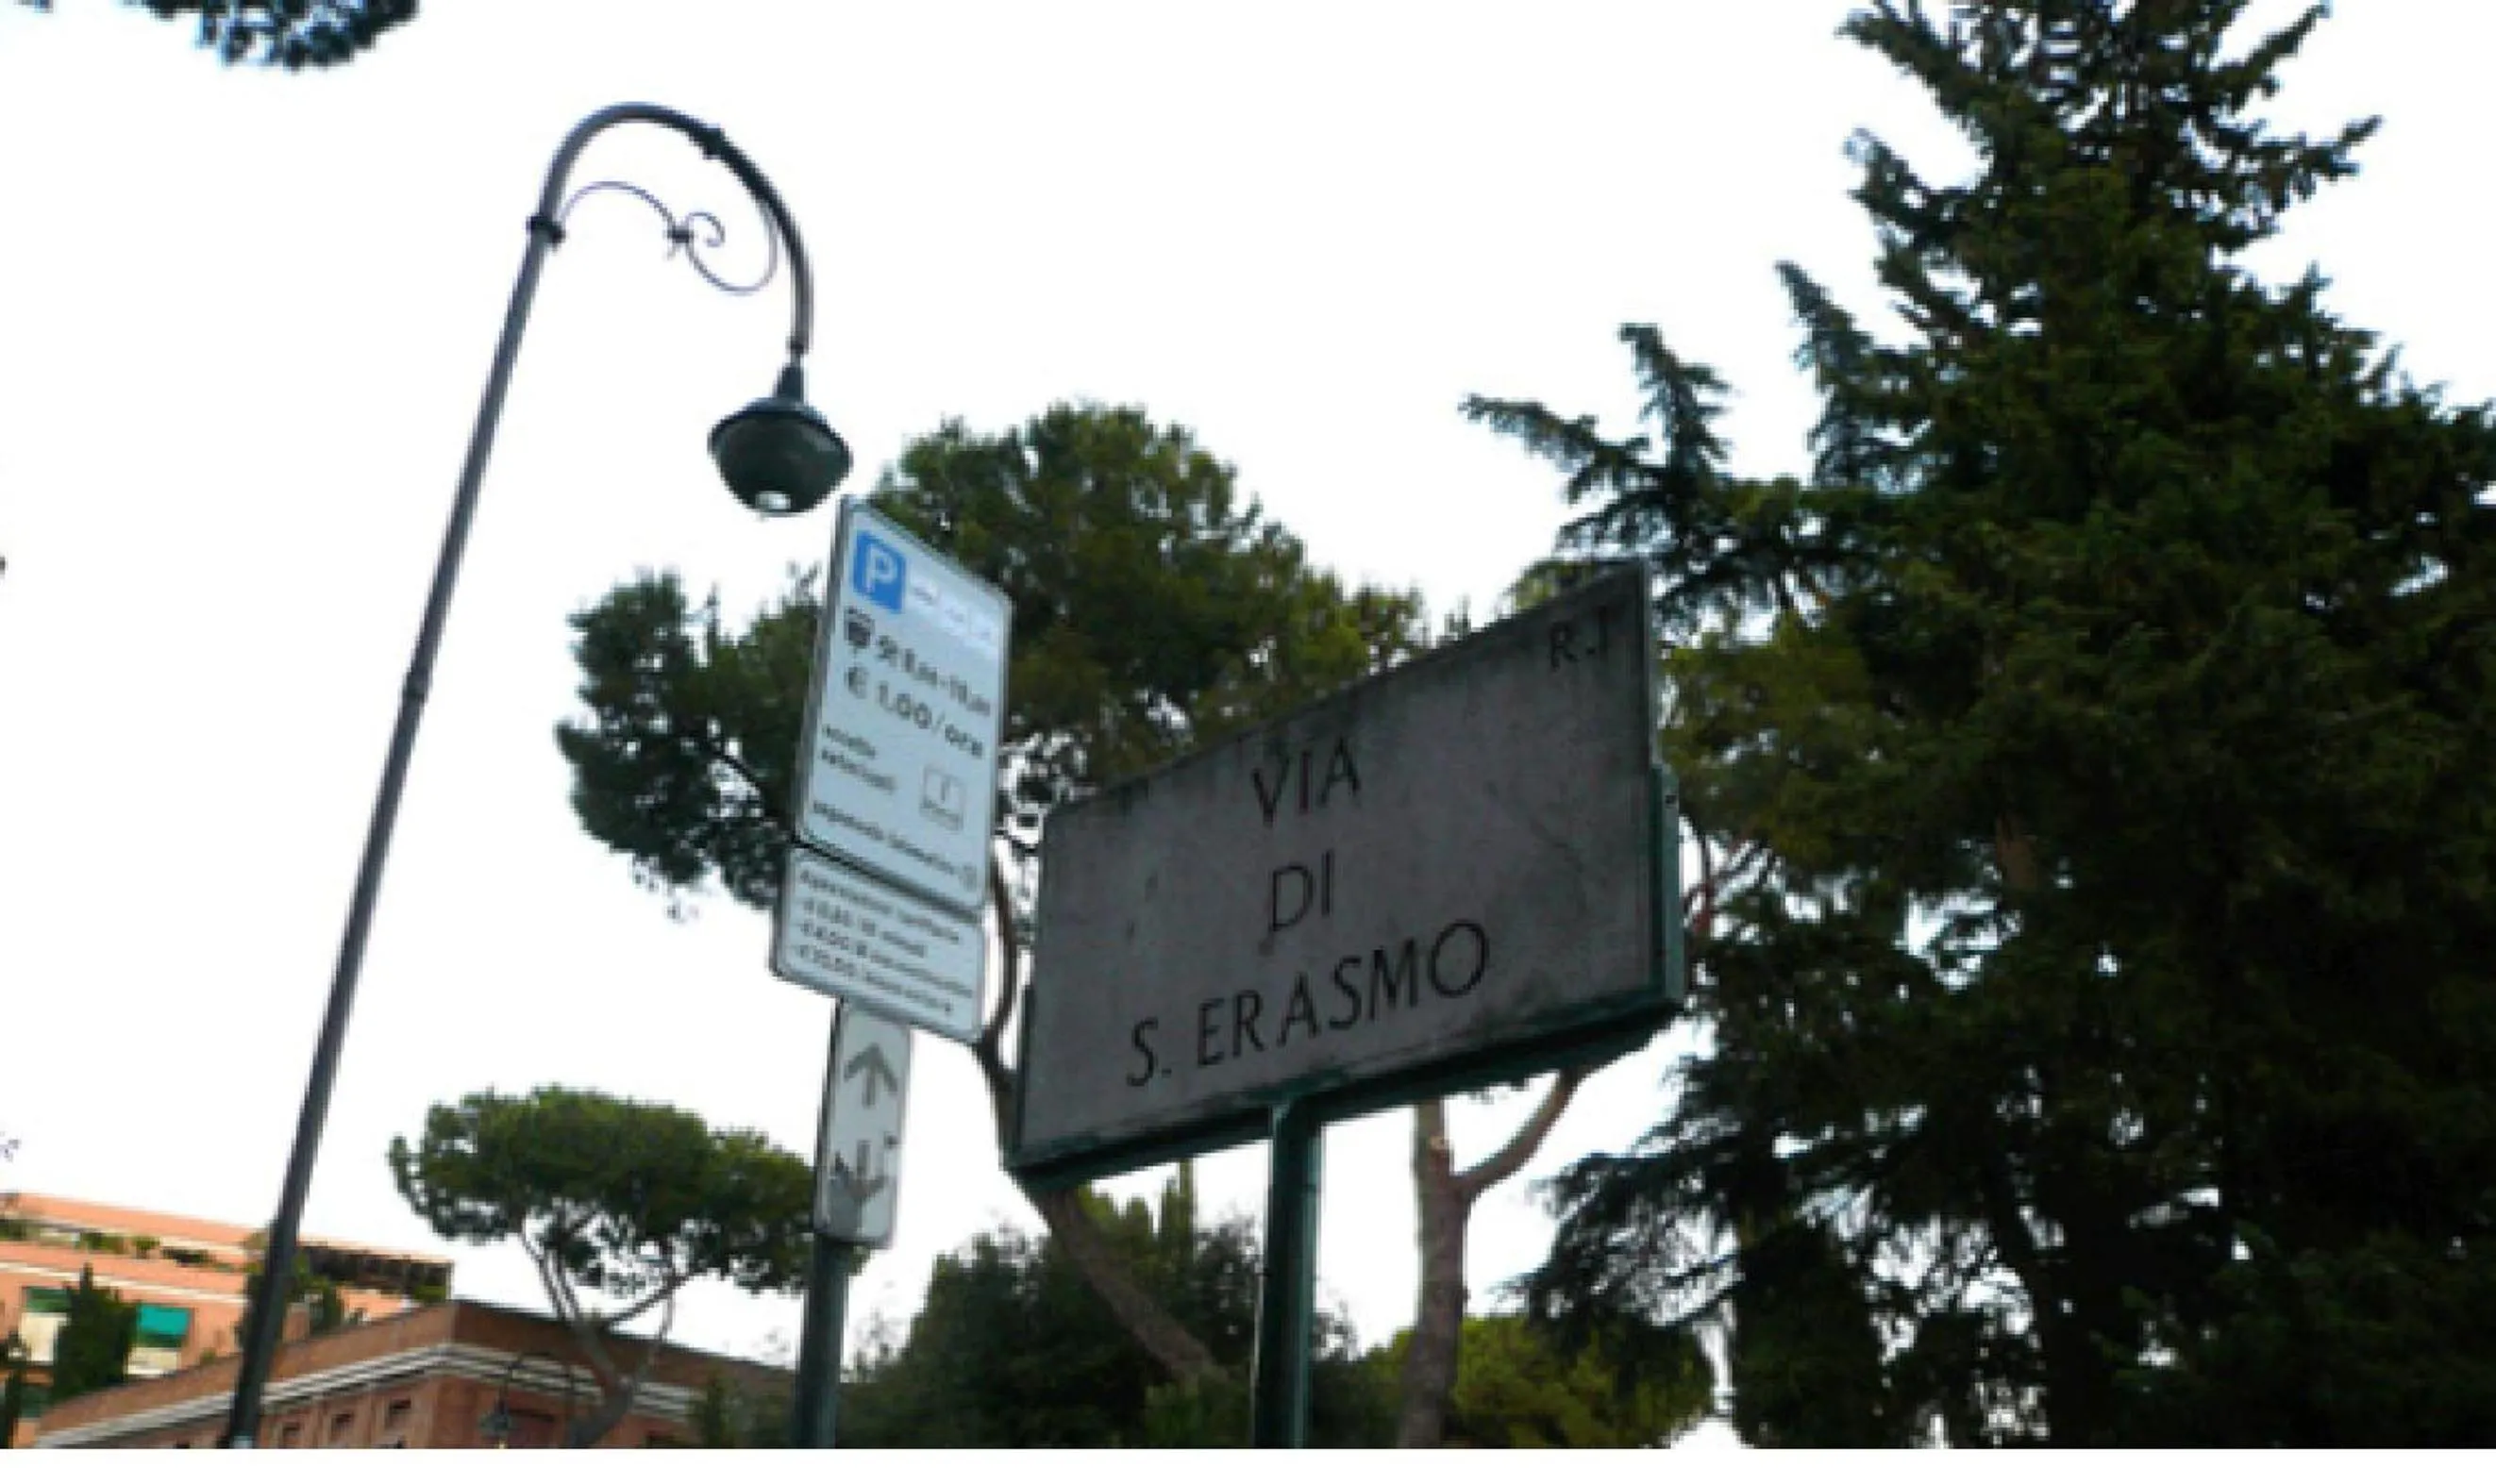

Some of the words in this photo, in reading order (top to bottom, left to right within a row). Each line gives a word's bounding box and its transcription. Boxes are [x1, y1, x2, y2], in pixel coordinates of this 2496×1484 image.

[863, 542, 899, 593] P
[1250, 736, 1361, 824] VIA
[1266, 851, 1332, 934] DI
[1125, 1017, 1173, 1088] S.
[1196, 918, 1491, 1068] ERASMO
